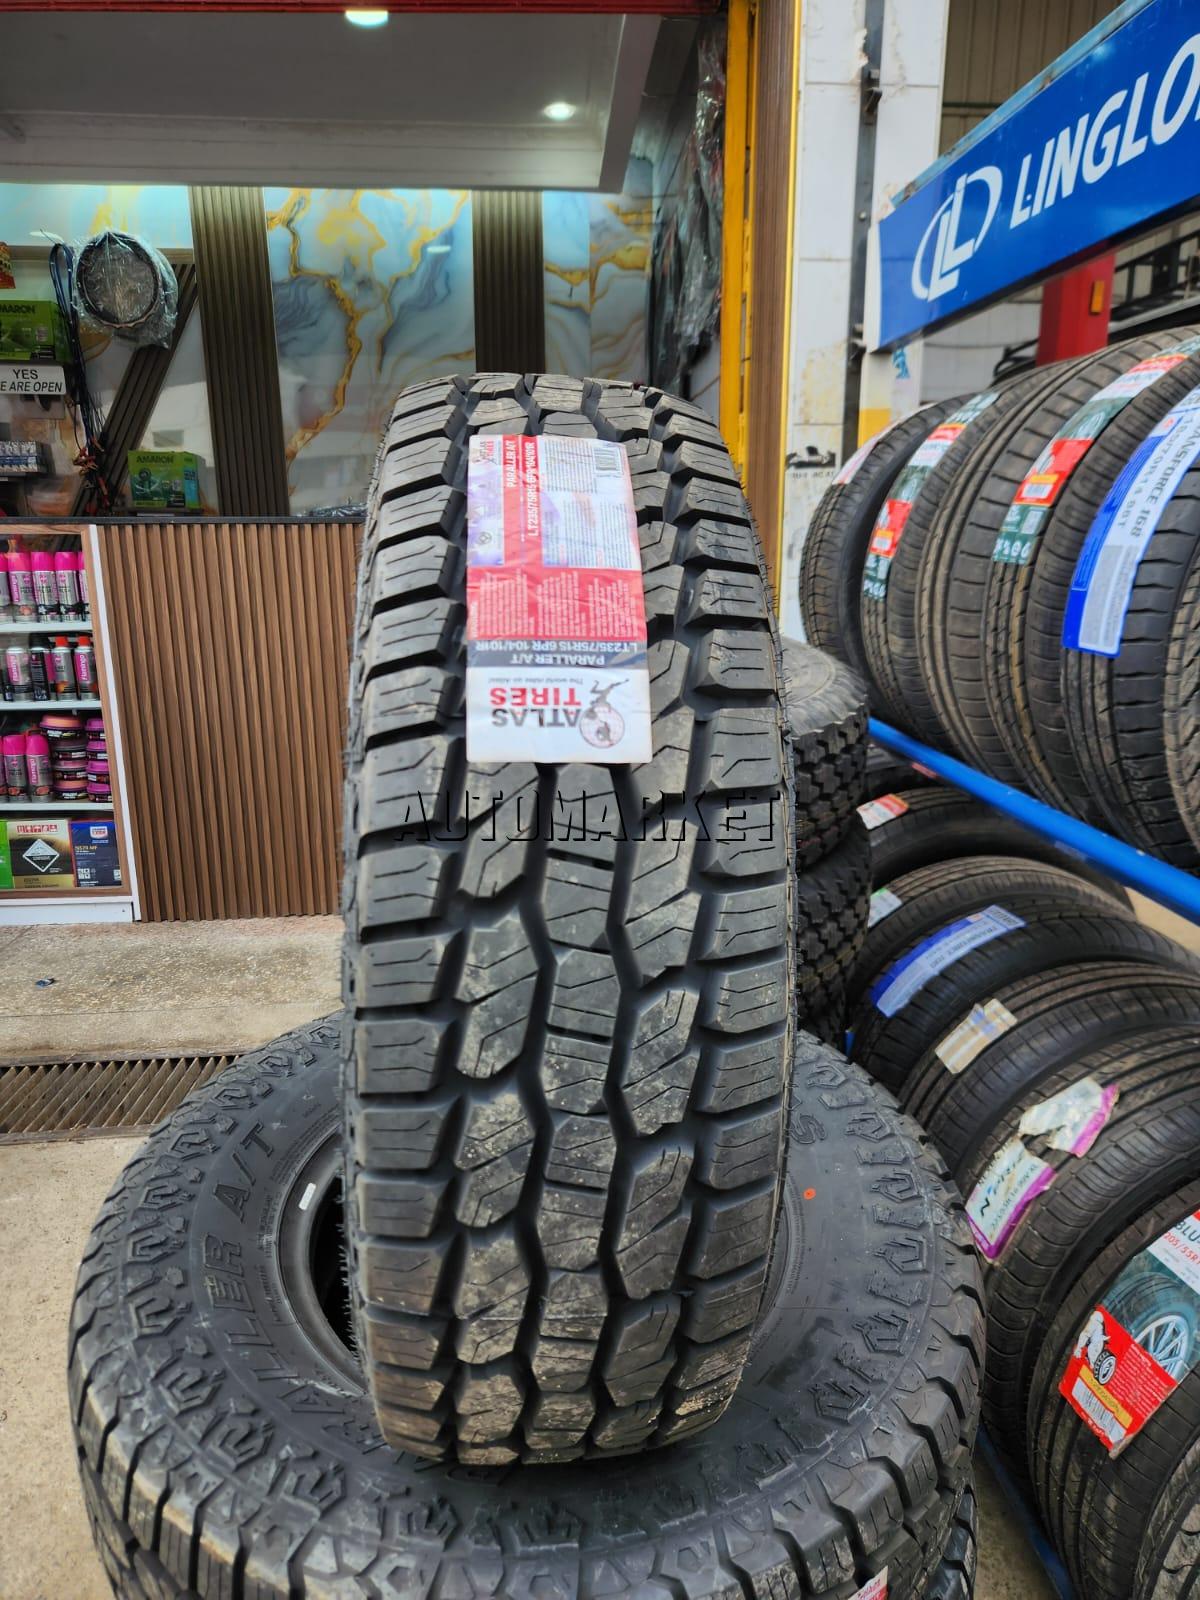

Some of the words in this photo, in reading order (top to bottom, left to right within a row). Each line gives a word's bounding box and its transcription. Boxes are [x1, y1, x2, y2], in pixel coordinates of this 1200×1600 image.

[1010, 31, 1200, 231] LINGLO
[13, 369, 38, 380] YES
[9, 381, 31, 391] ARE
[33, 382, 62, 393] OPEN
[1146, 426, 1200, 505] ANSFORCE
[532, 641, 557, 651] 6PR
[559, 641, 637, 652] LT235/75R15
[509, 653, 533, 664] A/T
[534, 653, 605, 664] PARALLER
[489, 687, 581, 706] TIRES
[490, 708, 581, 728] ATLAS
